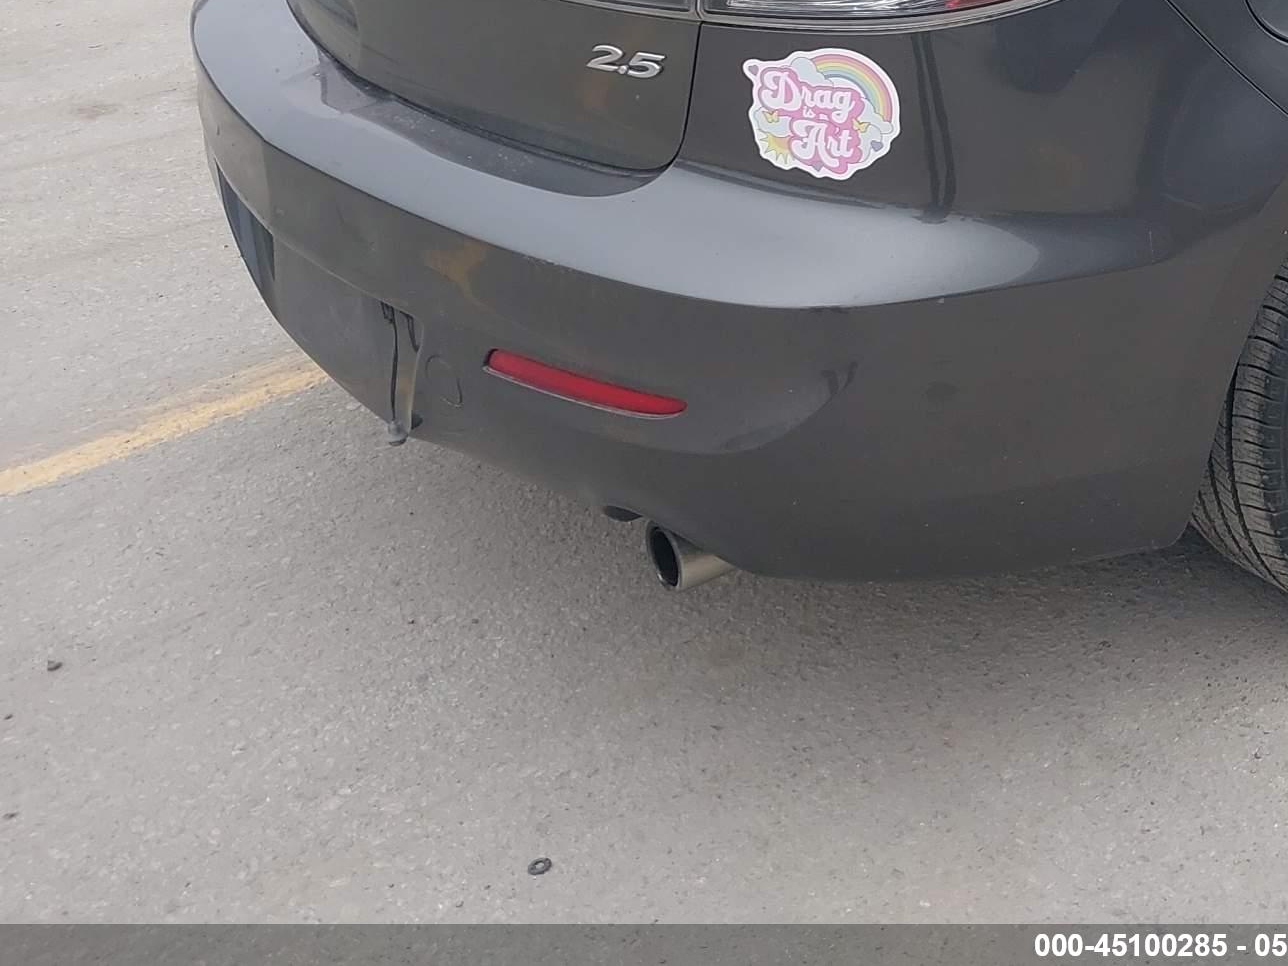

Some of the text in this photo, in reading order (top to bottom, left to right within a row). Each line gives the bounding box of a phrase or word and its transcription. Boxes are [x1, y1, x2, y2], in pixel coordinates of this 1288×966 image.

[586, 44, 666, 79] 2.5
[761, 70, 856, 124] Drag
[789, 119, 854, 168] Art
